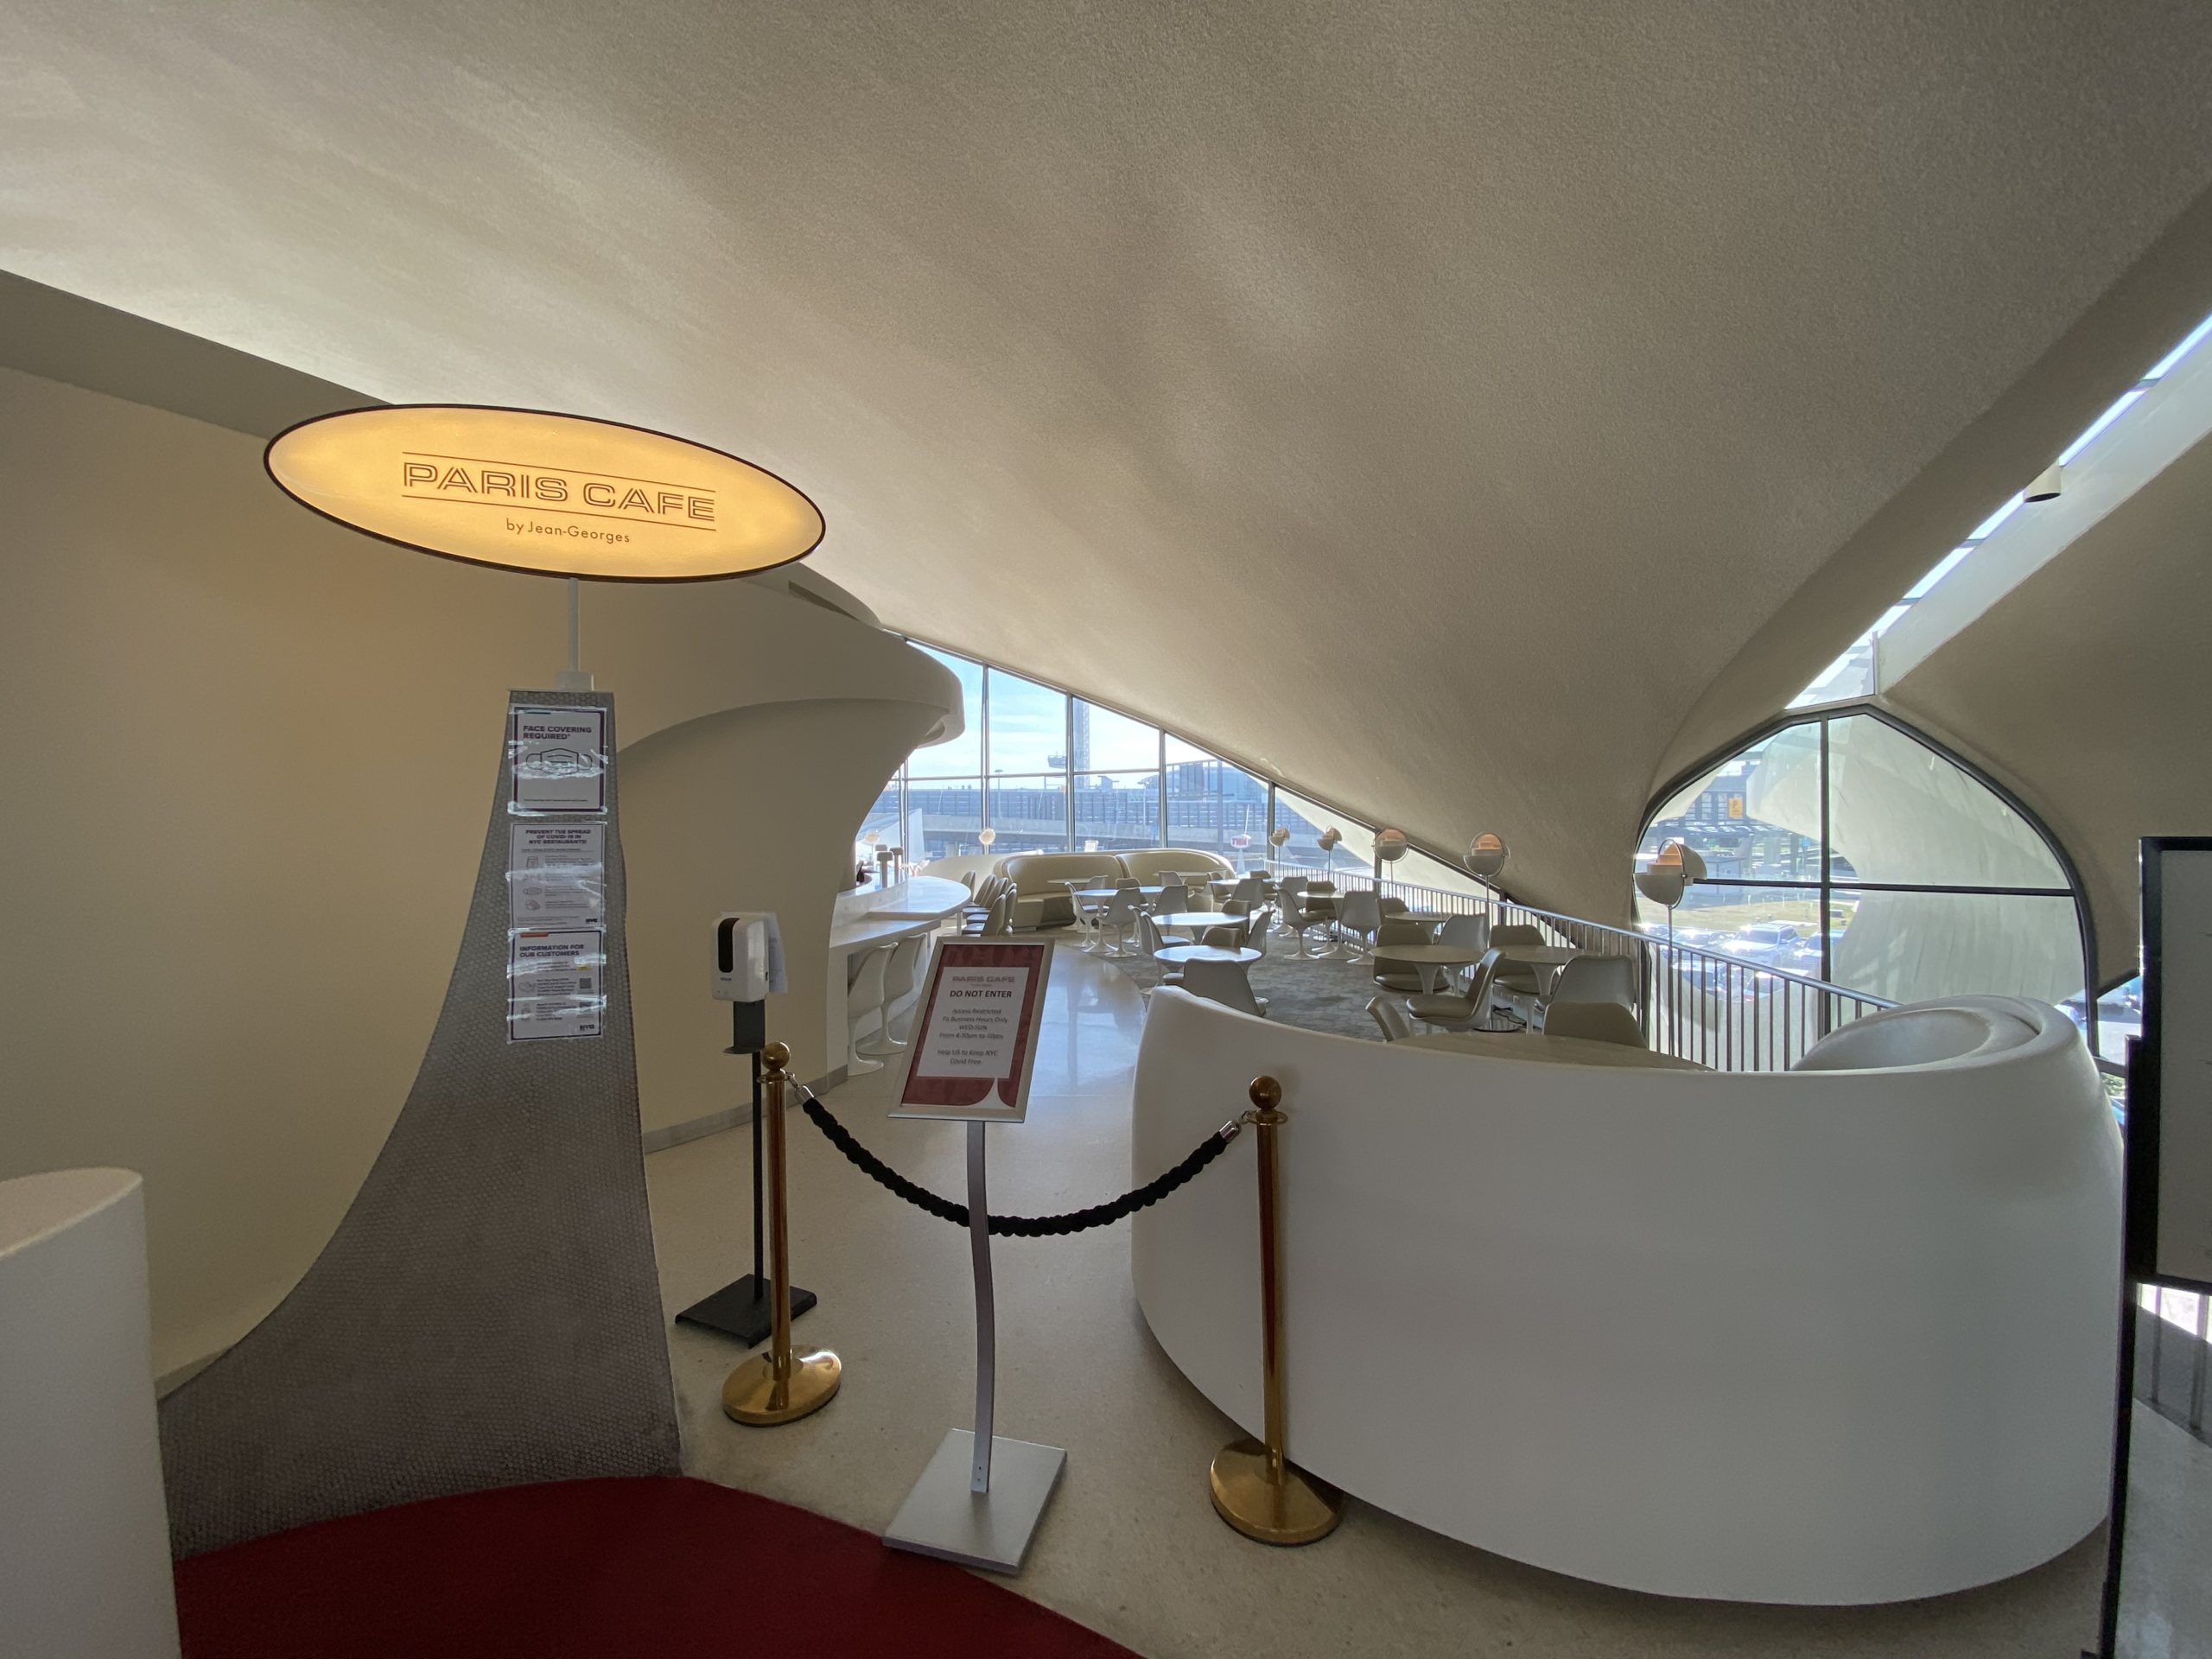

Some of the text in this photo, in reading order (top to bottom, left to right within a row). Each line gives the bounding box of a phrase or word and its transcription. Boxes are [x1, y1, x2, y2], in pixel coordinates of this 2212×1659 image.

[403, 461, 715, 523] PARIS CAFE
[505, 518, 631, 544] by Jean-Georges
